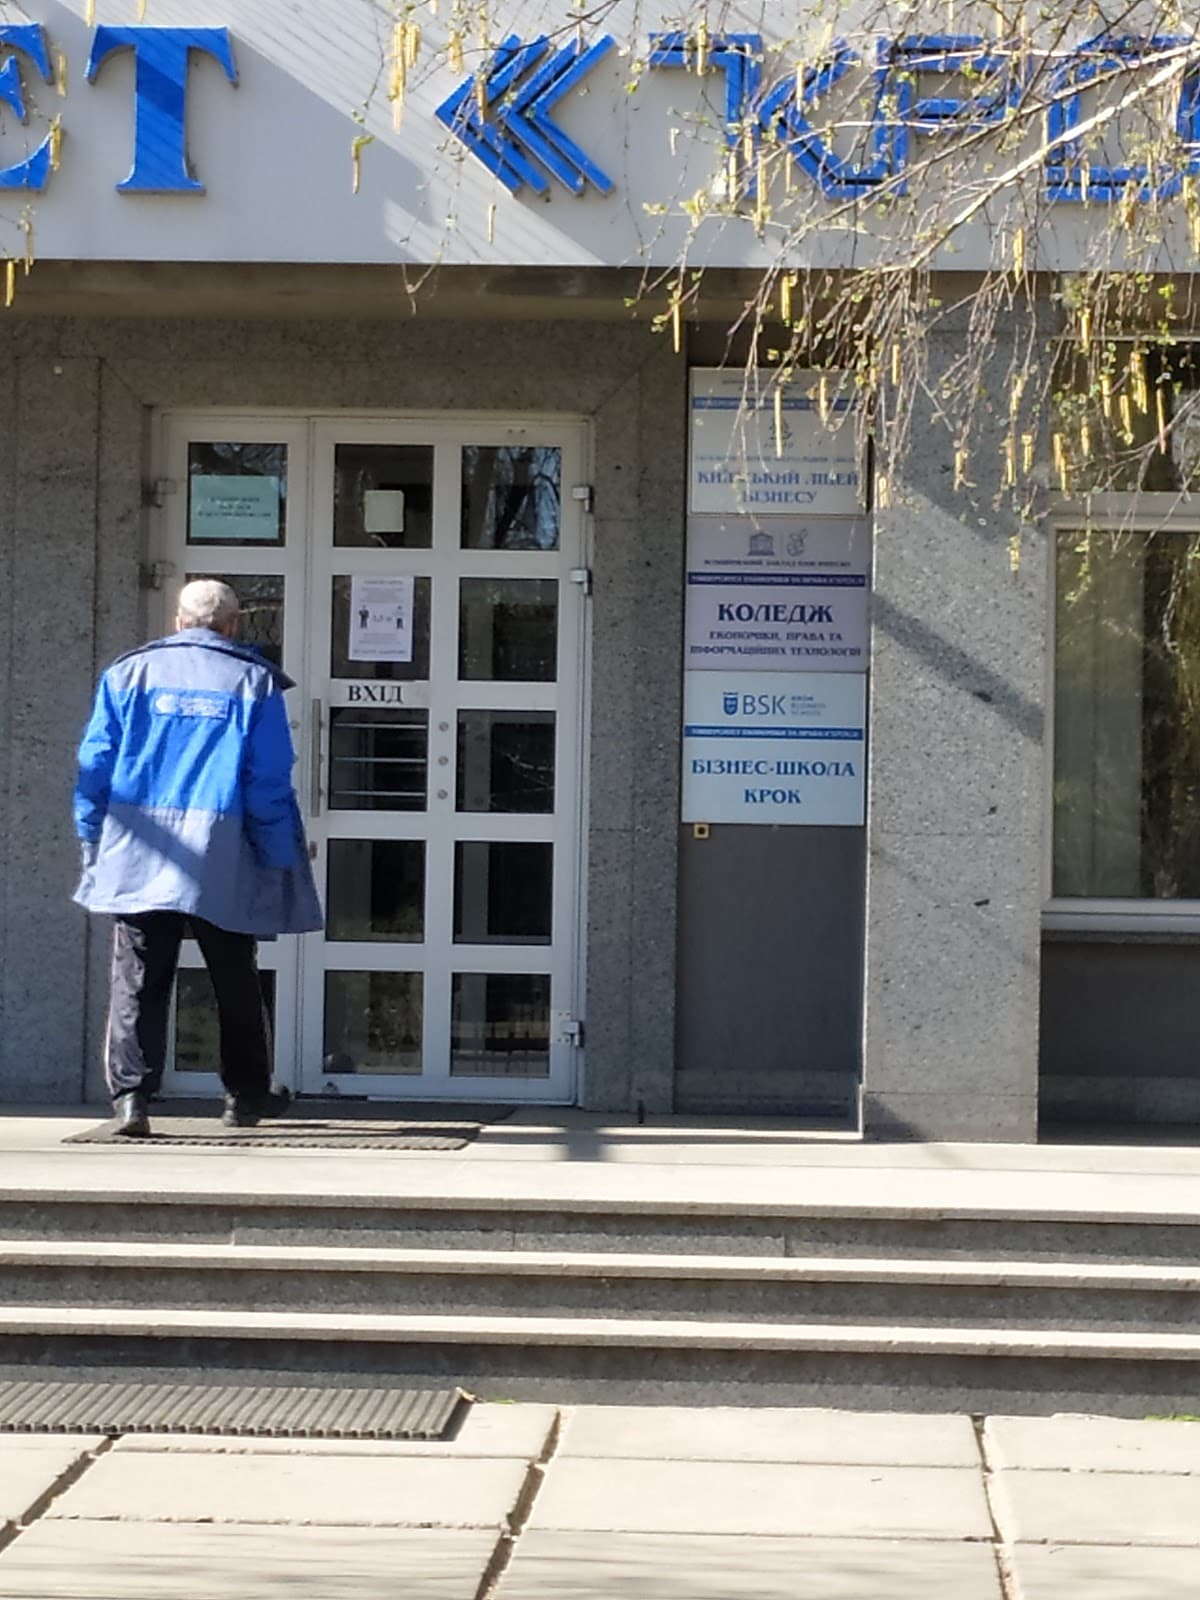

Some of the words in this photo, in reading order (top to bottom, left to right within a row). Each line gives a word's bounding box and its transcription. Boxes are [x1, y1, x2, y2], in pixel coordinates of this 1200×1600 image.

[697, 468, 800, 485] КИЇЬКИЙ
[742, 490, 817, 504] БІЗНЕСУ
[717, 603, 834, 624] КОЛЕДЖ
[785, 632, 825, 642] ПРАВА
[829, 633, 843, 642] ТА
[348, 685, 404, 704] ВХІД
[743, 694, 787, 715] BSK
[692, 759, 855, 777] БІЗНЕС-ШКОЛА
[744, 789, 801, 804] КРОК
